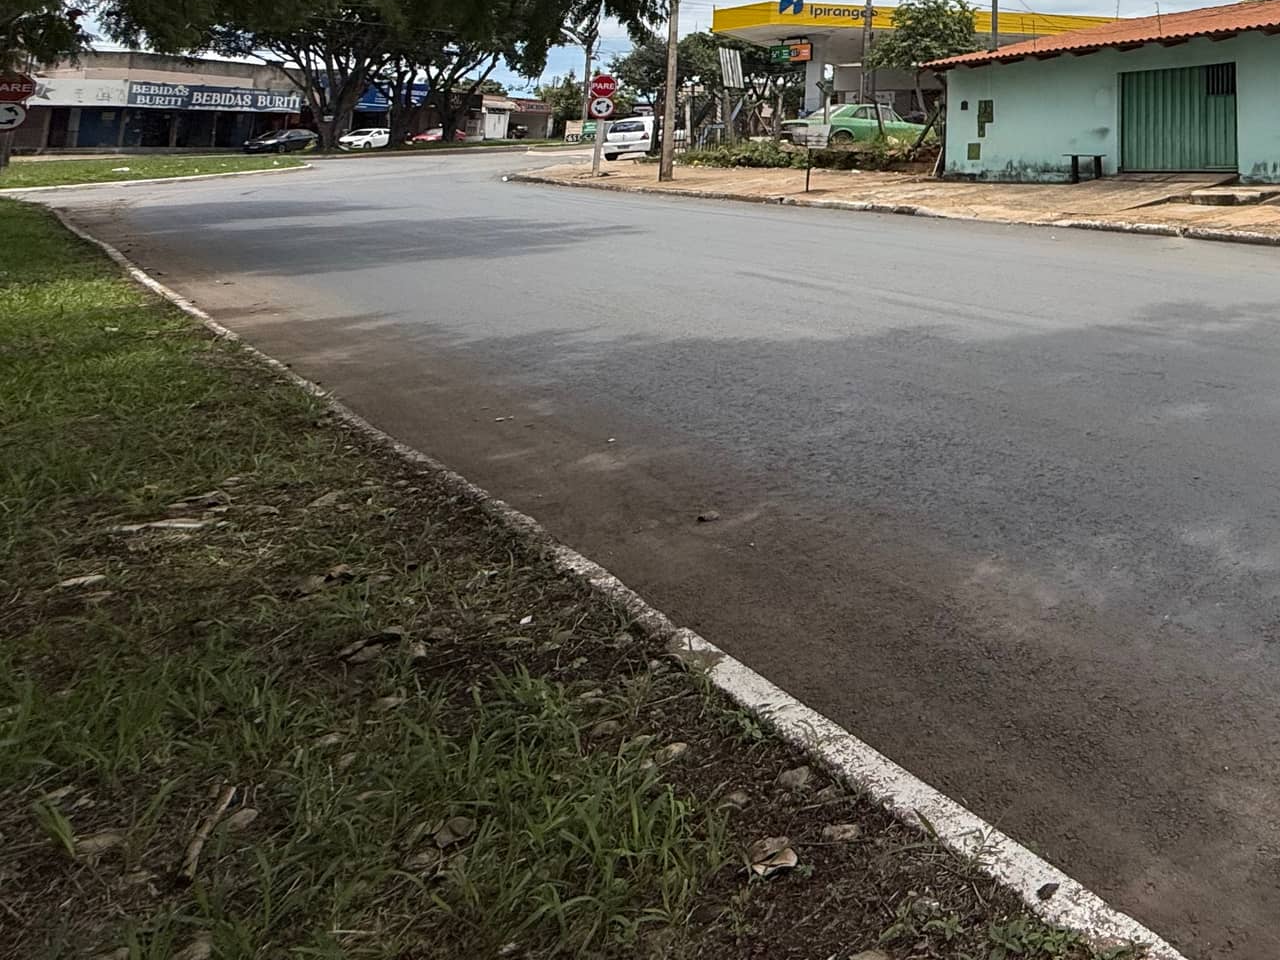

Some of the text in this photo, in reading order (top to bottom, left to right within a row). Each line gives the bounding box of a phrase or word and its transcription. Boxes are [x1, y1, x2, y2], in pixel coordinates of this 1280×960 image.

[0, 83, 33, 92] ARE
[131, 84, 190, 97] BEBIDAS
[592, 82, 615, 90] PARE
[191, 91, 300, 109] BEBIDAS BURITI
